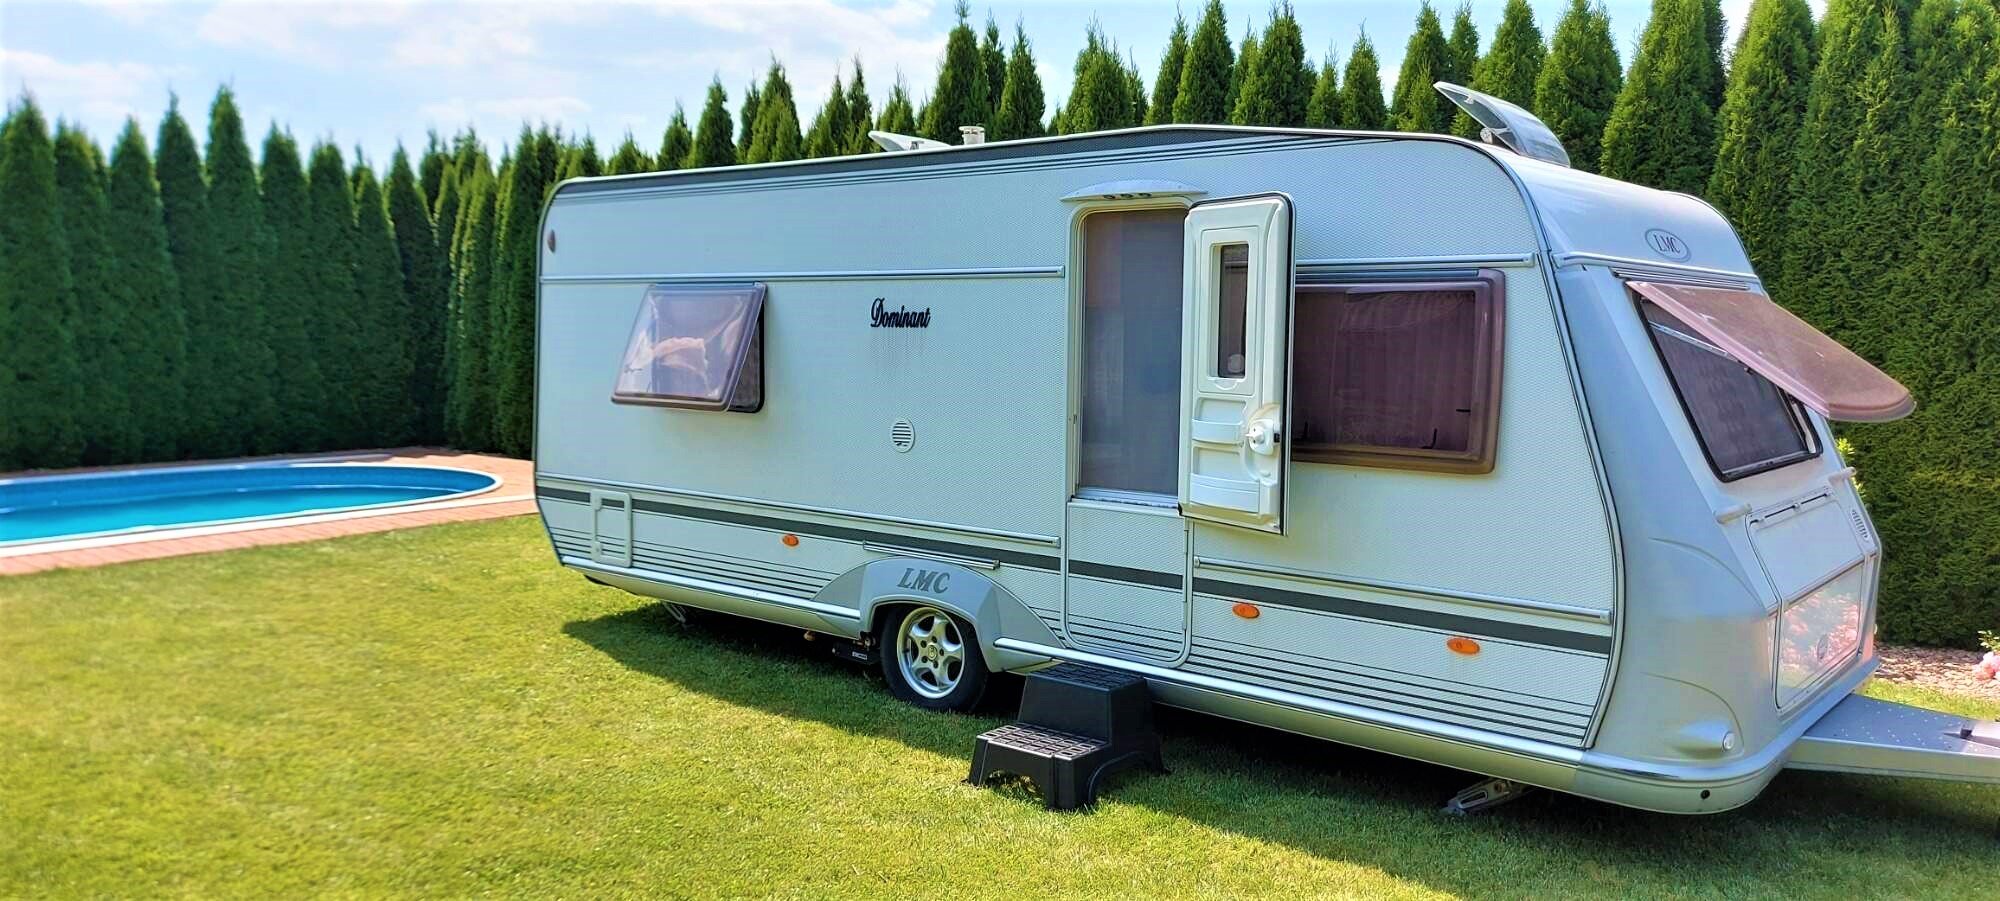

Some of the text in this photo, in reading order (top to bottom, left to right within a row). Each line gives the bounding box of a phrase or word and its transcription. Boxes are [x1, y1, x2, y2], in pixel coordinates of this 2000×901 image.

[1653, 234, 1681, 254] LMC
[870, 297, 931, 328] Dominant
[896, 567, 951, 594] LMC
